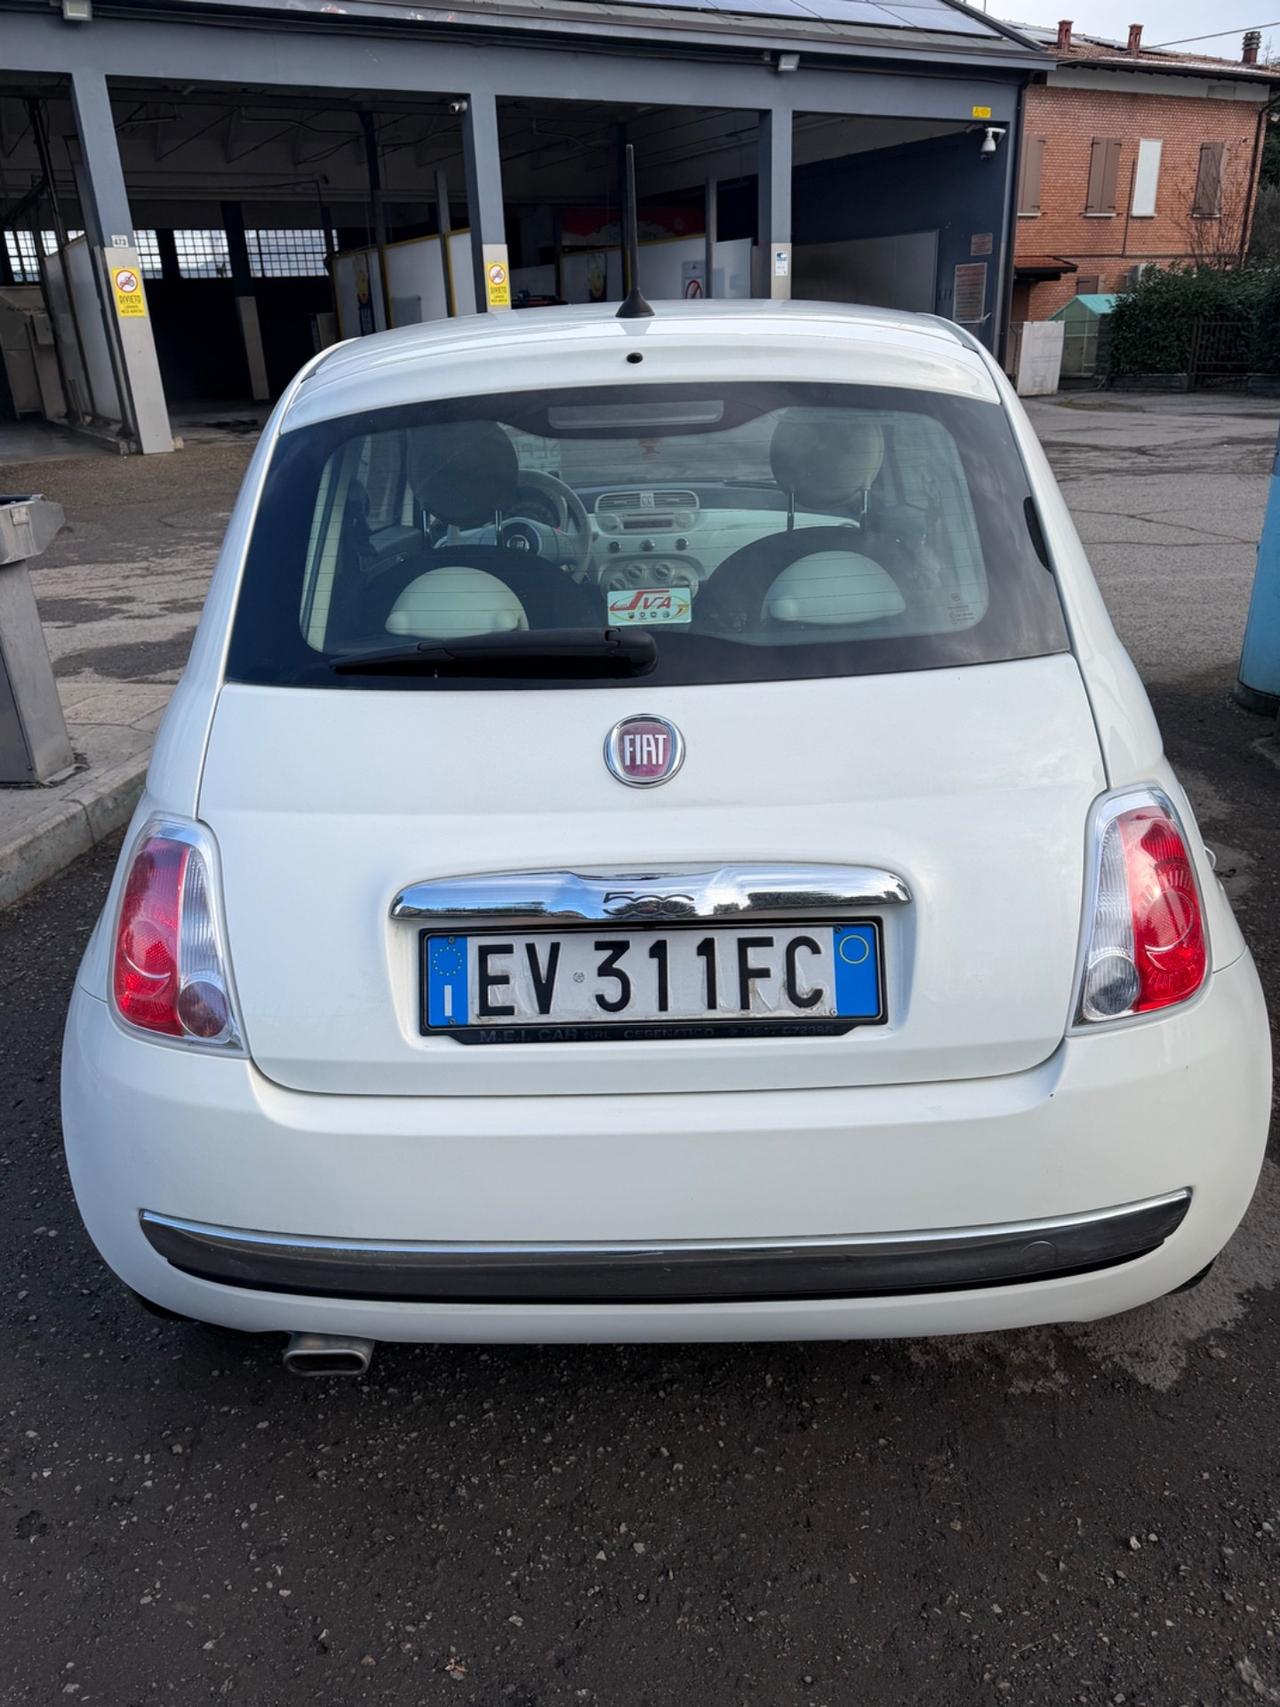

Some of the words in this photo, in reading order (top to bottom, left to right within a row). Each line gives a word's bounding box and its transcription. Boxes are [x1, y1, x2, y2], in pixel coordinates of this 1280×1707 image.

[623, 734, 667, 766] FIAT
[602, 891, 695, 916] 500
[538, 1028, 577, 1041] CAR
